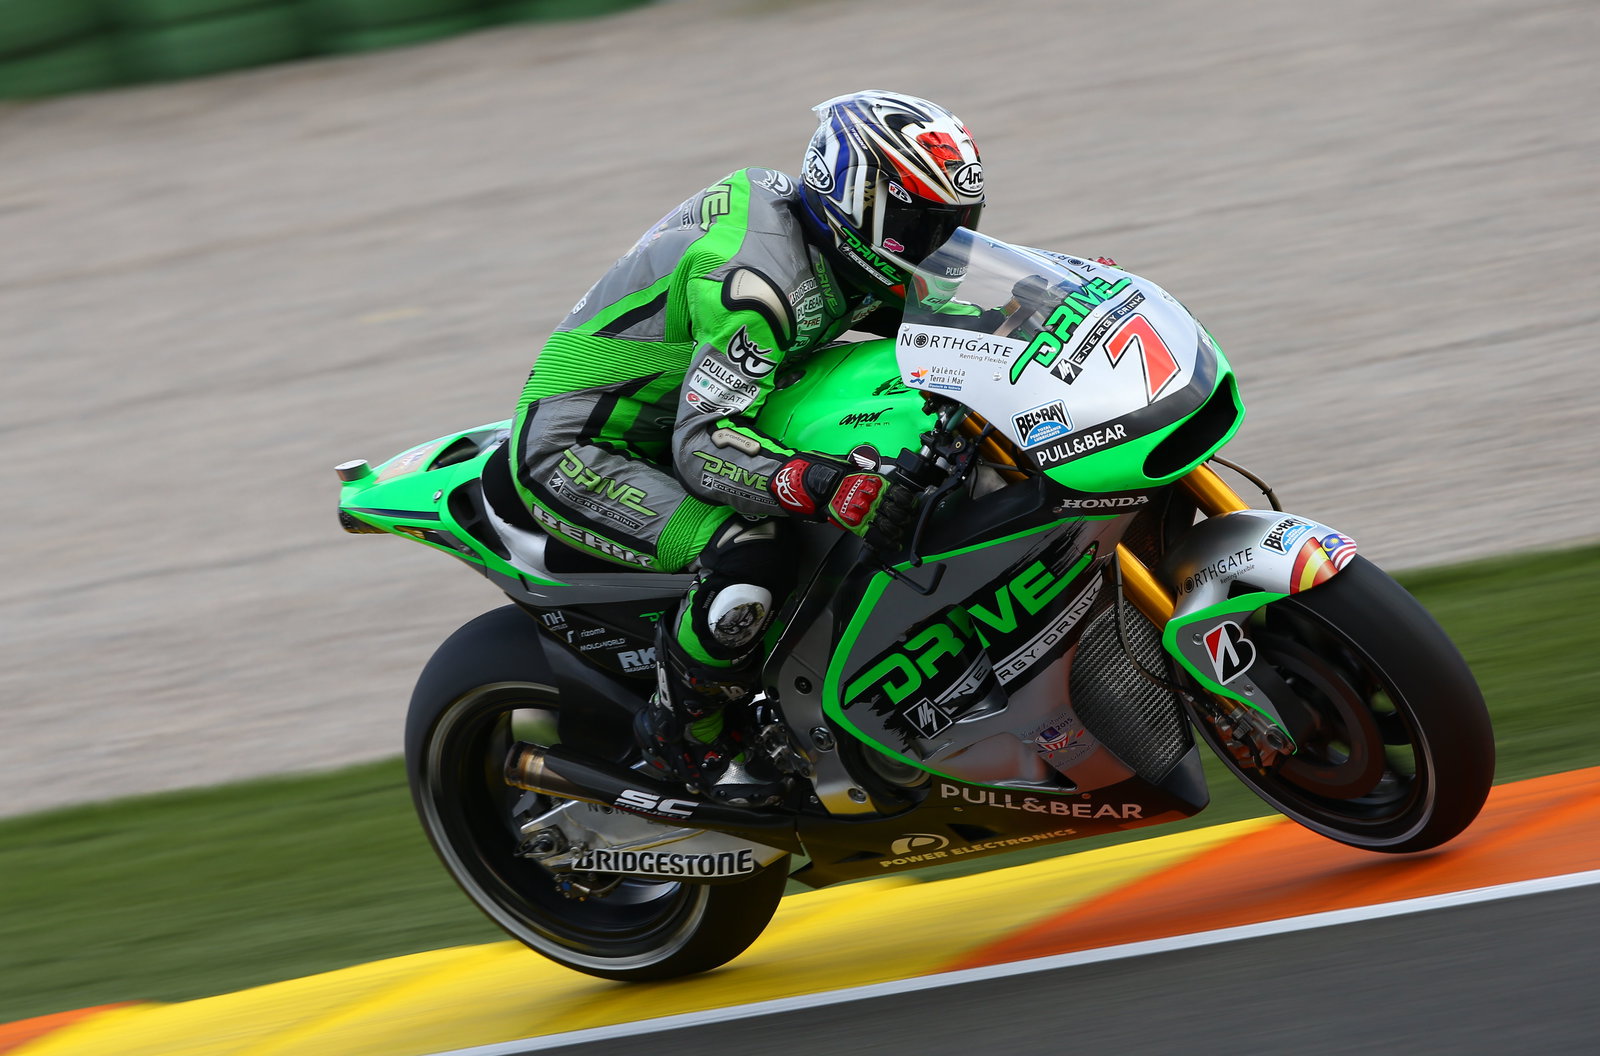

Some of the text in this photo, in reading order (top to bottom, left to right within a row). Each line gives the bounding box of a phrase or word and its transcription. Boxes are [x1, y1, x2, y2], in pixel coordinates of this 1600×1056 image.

[841, 226, 902, 282] DRIVE
[1009, 277, 1133, 385] DRIVE
[1074, 314, 1118, 363] ENERGY
[1116, 292, 1145, 316] DRINK
[900, 333, 1014, 358] NORTHGATE
[959, 353, 1008, 365] Renting Flexible
[1102, 313, 1181, 407] 7
[929, 375, 946, 384] Terra
[952, 376, 964, 385] Mar
[931, 366, 966, 376] València
[1036, 424, 1128, 467] PULL&BEAR
[558, 449, 659, 517] DRIVE
[1061, 495, 1149, 509] HONDA
[606, 511, 637, 529] DRINK
[843, 542, 1098, 707] DRIVE
[1043, 587, 1100, 646] DRINK
[617, 647, 656, 669] RK
[1055, 717, 1073, 731] 2015
[615, 789, 700, 816] SC
[941, 783, 1143, 819] PULL&BEAR
[573, 849, 754, 876] BRIDGESTONE
[879, 828, 1077, 868] POWER ELECTRONICS
